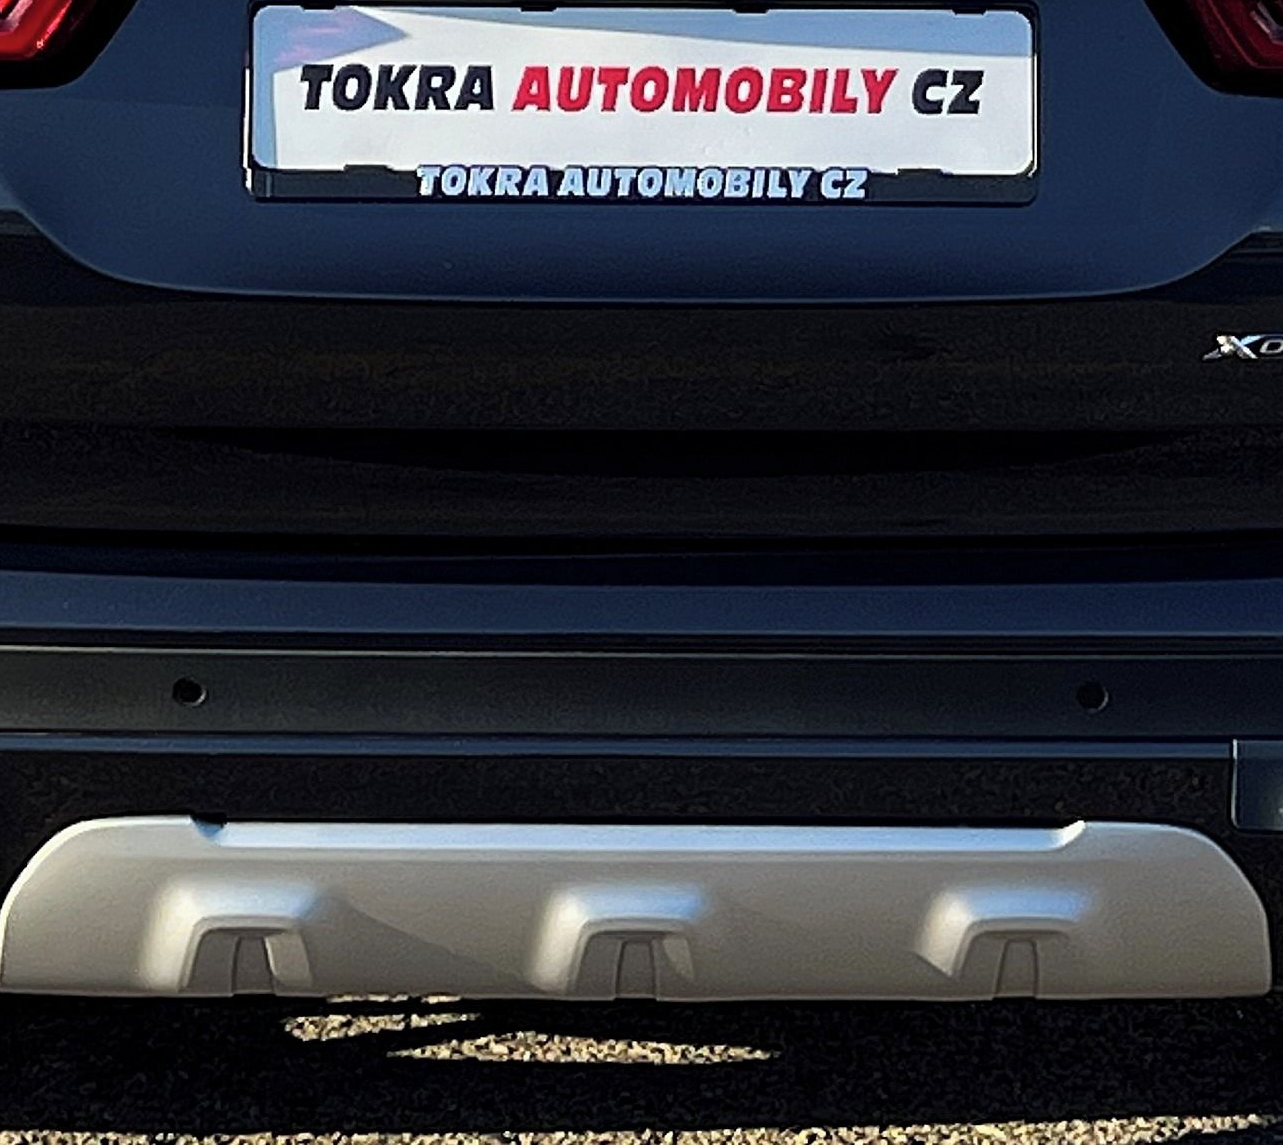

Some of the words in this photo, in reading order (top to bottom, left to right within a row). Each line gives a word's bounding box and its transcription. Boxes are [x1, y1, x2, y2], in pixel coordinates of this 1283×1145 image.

[300, 63, 494, 112] TOKRA
[511, 64, 899, 115] AUTOMOBILY
[911, 69, 985, 116] CZ
[417, 164, 550, 198] TOKRA
[557, 166, 817, 199] AUTOMOBILY
[819, 167, 872, 200] CZ
